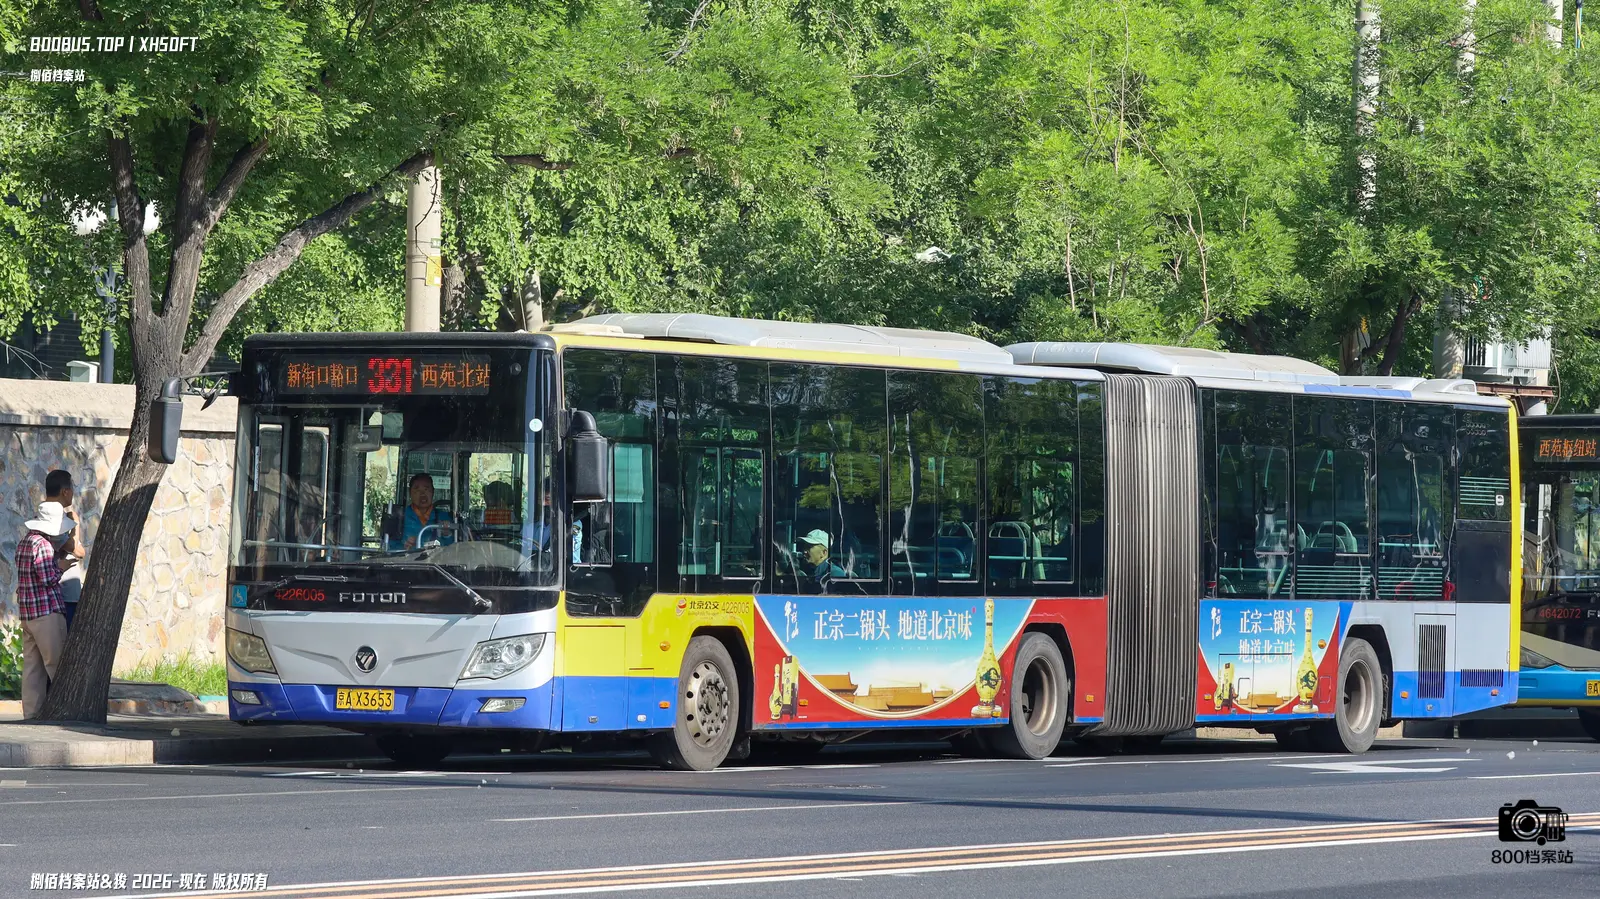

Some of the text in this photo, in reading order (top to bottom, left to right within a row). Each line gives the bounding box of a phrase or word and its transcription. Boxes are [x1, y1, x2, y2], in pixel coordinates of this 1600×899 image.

[287, 358, 491, 393] 新街口豁口 331 西苑北站
[1539, 438, 1597, 457] 西苑枢纽站
[274, 588, 325, 602] 4226005
[339, 592, 406, 604] FOTON
[690, 600, 719, 610] 北京公交
[721, 601, 750, 614] 4226005
[1539, 608, 1581, 619] 4642072
[813, 609, 973, 641] 正宗二锅头 地道北京味
[1239, 608, 1296, 635] 正宗二锅头
[1238, 638, 1296, 664] 地道北京味
